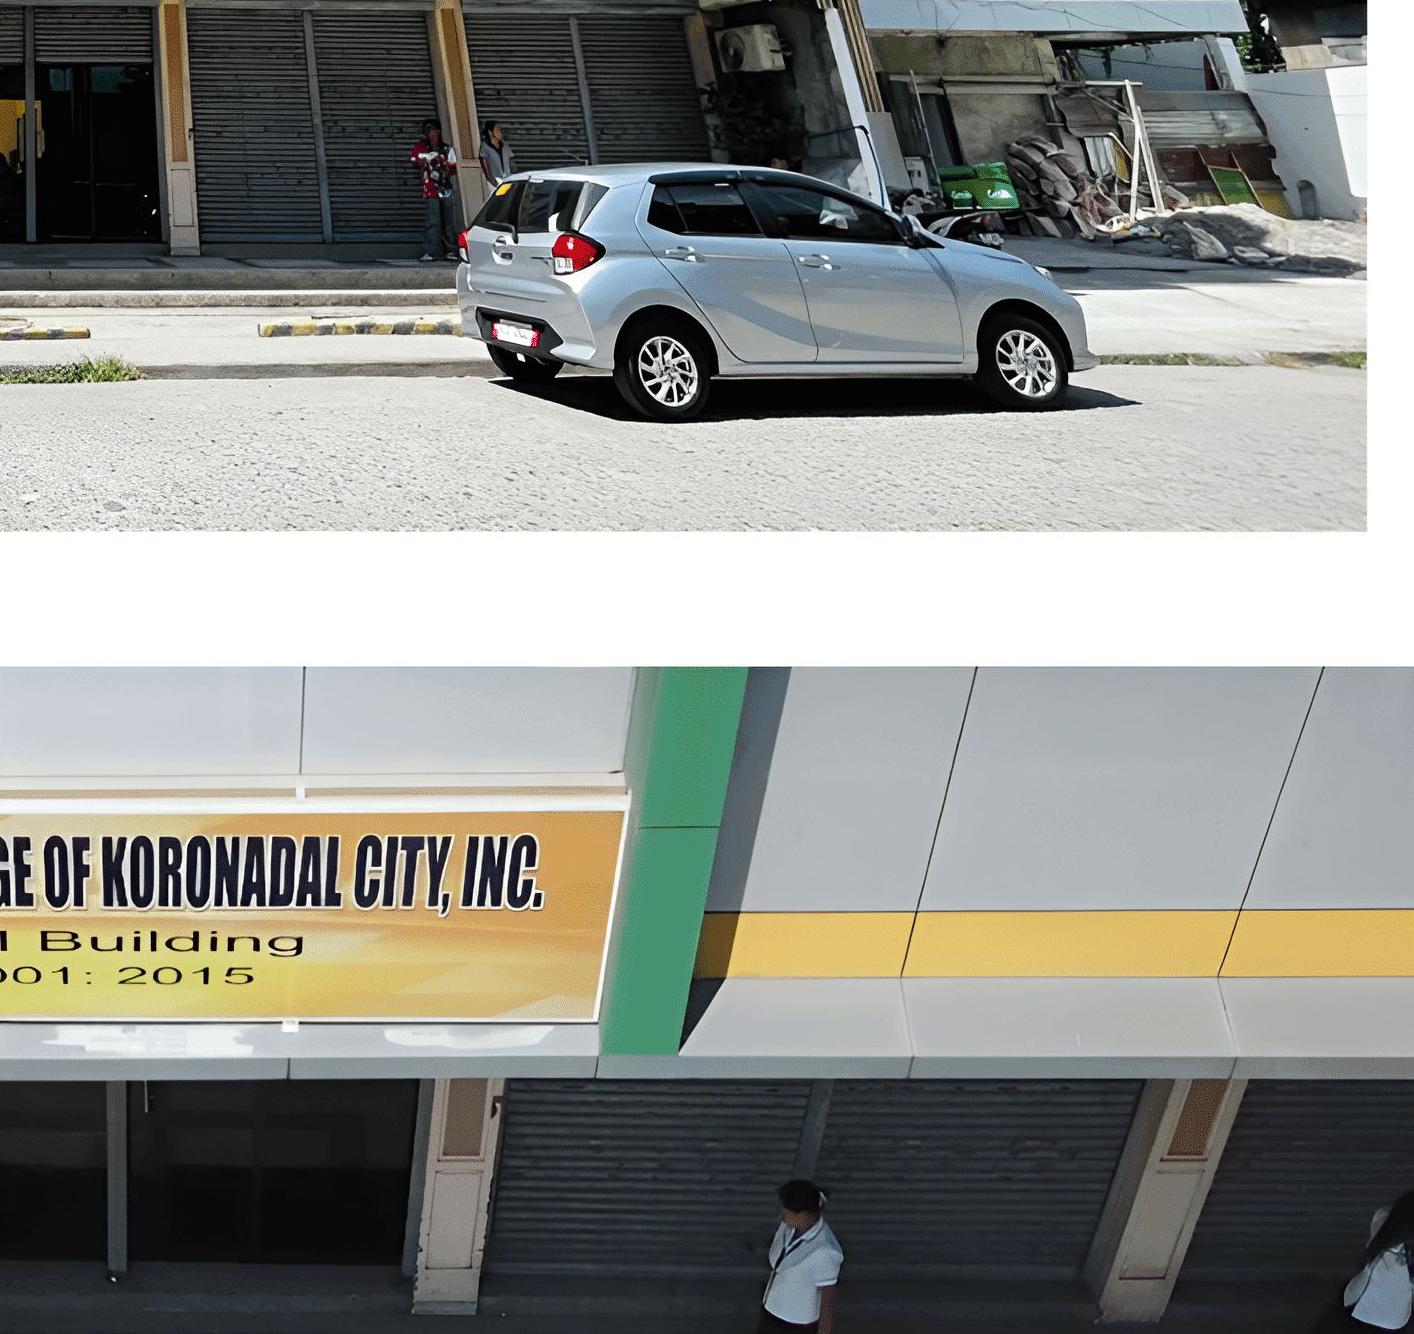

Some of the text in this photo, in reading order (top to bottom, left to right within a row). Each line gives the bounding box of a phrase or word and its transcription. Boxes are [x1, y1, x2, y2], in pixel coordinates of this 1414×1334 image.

[44, 835, 92, 909] OF
[103, 835, 343, 909] KORONADAL
[355, 834, 453, 915] CITY,
[461, 834, 543, 910] INC.
[41, 930, 305, 958] Building
[117, 967, 255, 986] 2015
